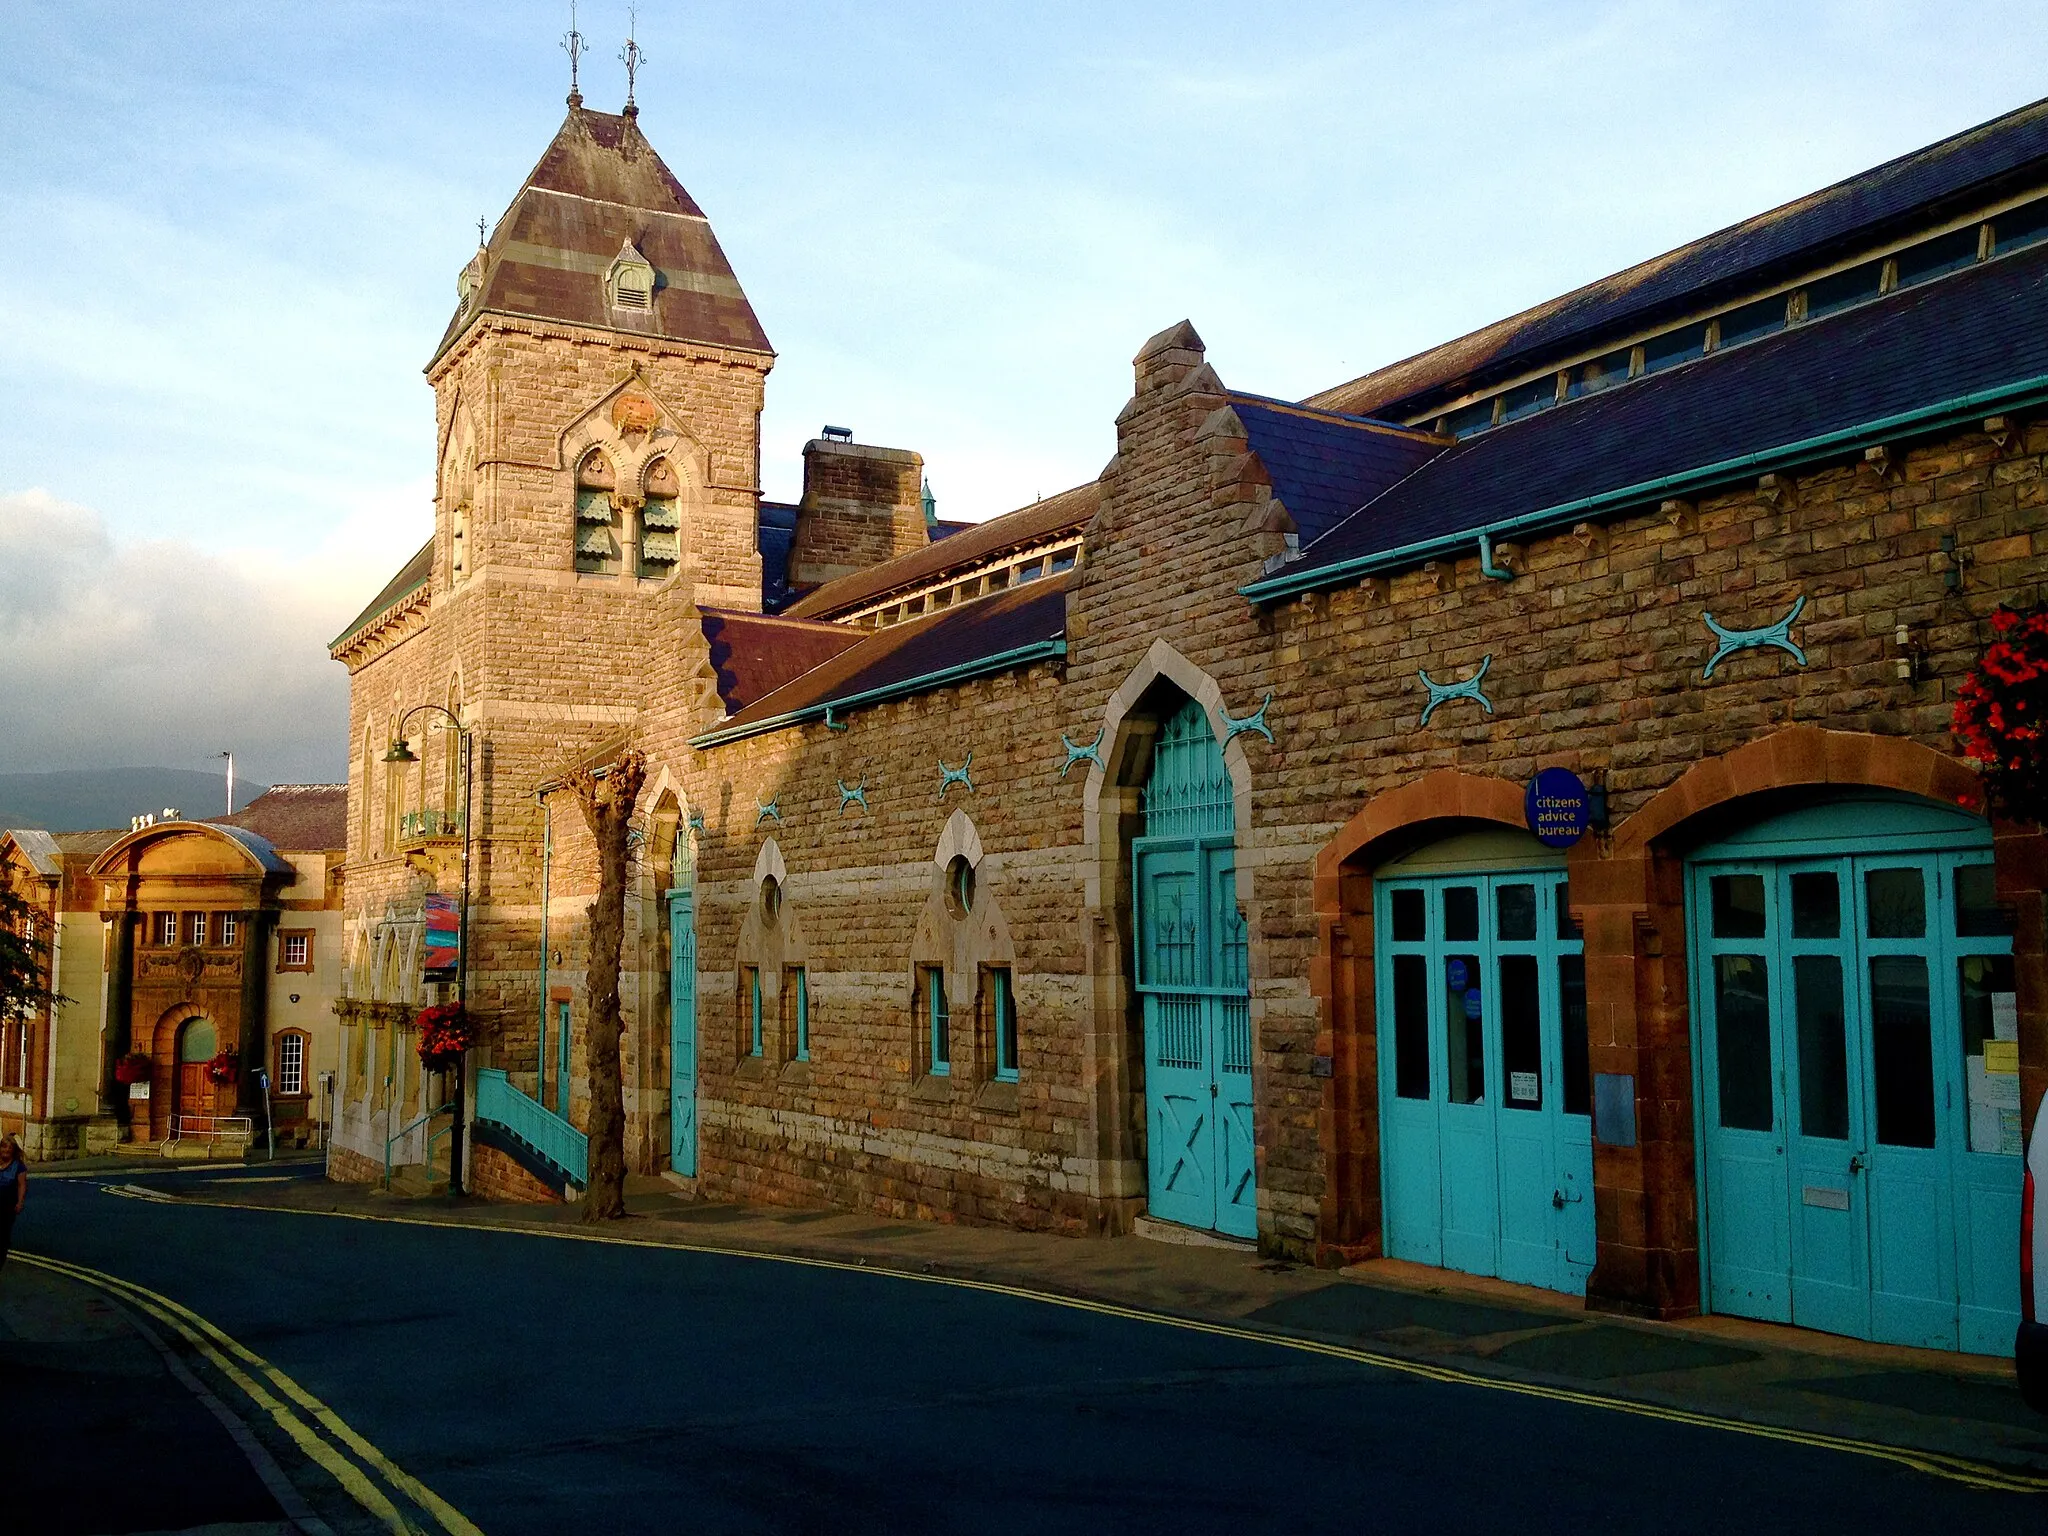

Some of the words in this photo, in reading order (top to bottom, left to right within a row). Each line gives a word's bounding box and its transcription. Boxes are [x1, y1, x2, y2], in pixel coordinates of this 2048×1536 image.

[1536, 796, 1582, 808] citizens
[1538, 810, 1576, 822] advice
[1538, 824, 1580, 836] bureau
